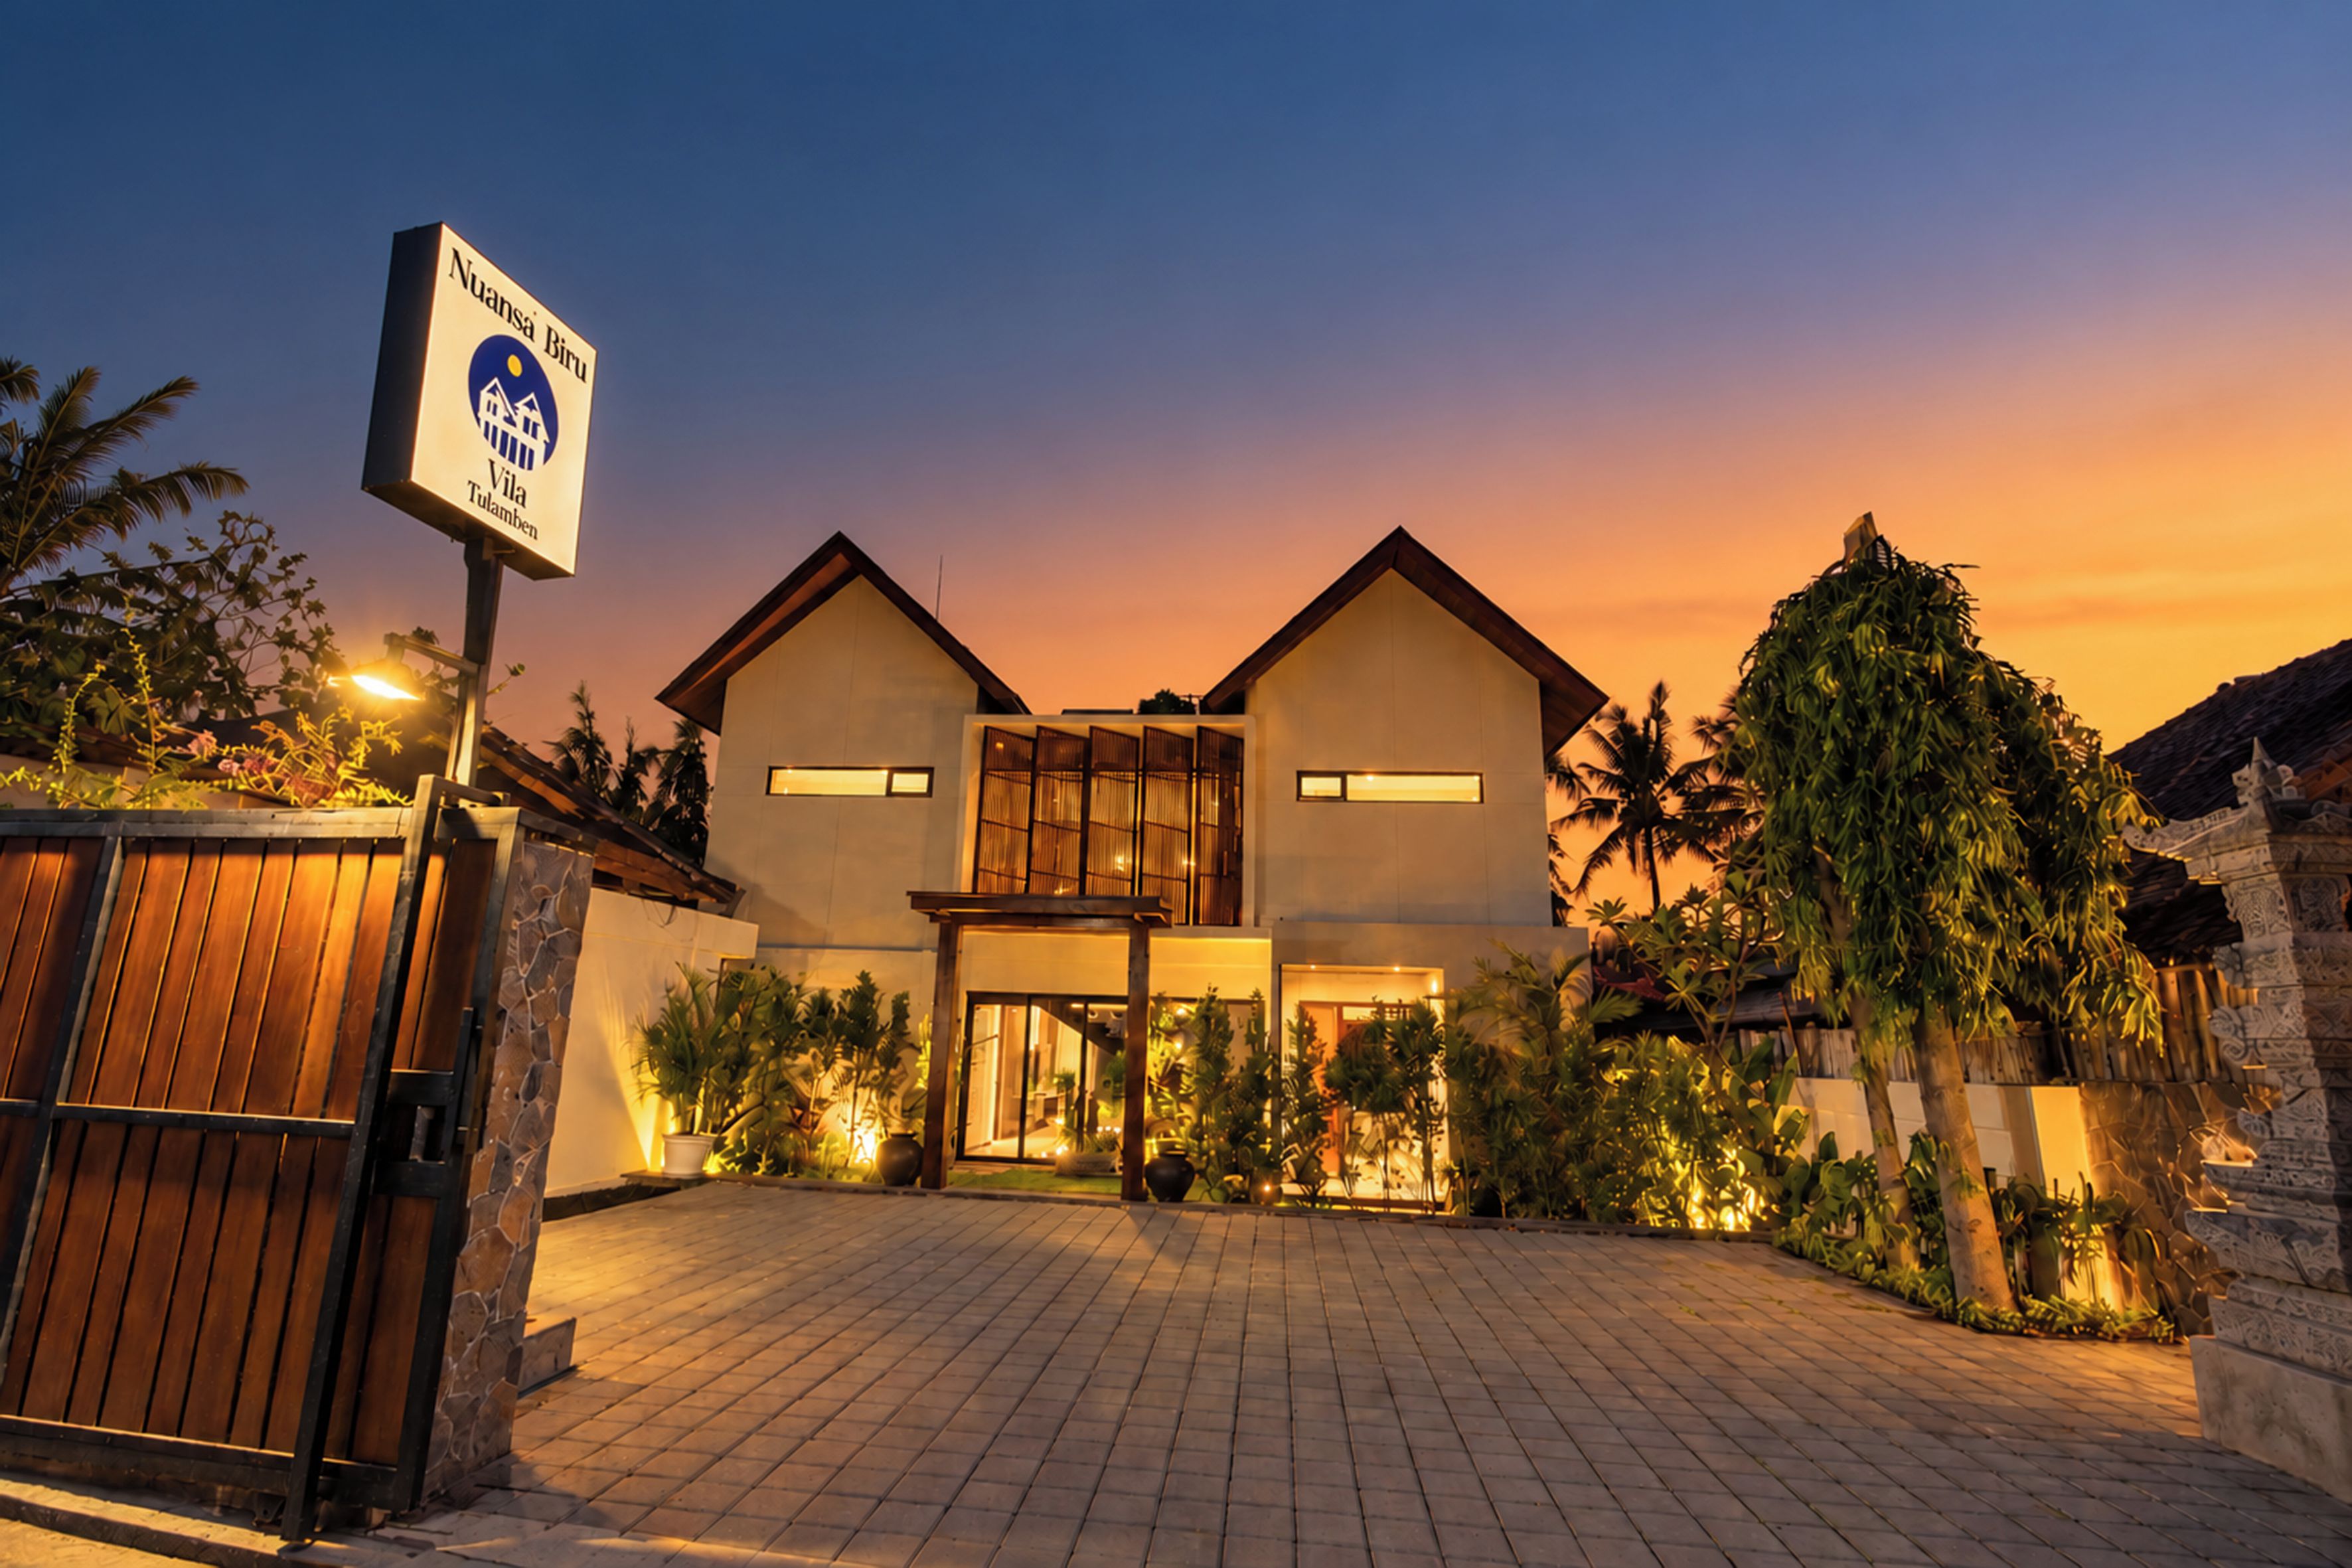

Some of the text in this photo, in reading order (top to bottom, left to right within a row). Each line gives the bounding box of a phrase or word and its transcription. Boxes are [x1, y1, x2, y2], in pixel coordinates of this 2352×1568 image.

[449, 247, 587, 383] Nuansa Biru
[467, 480, 538, 540] Tulamben
[488, 458, 526, 509] Vila
